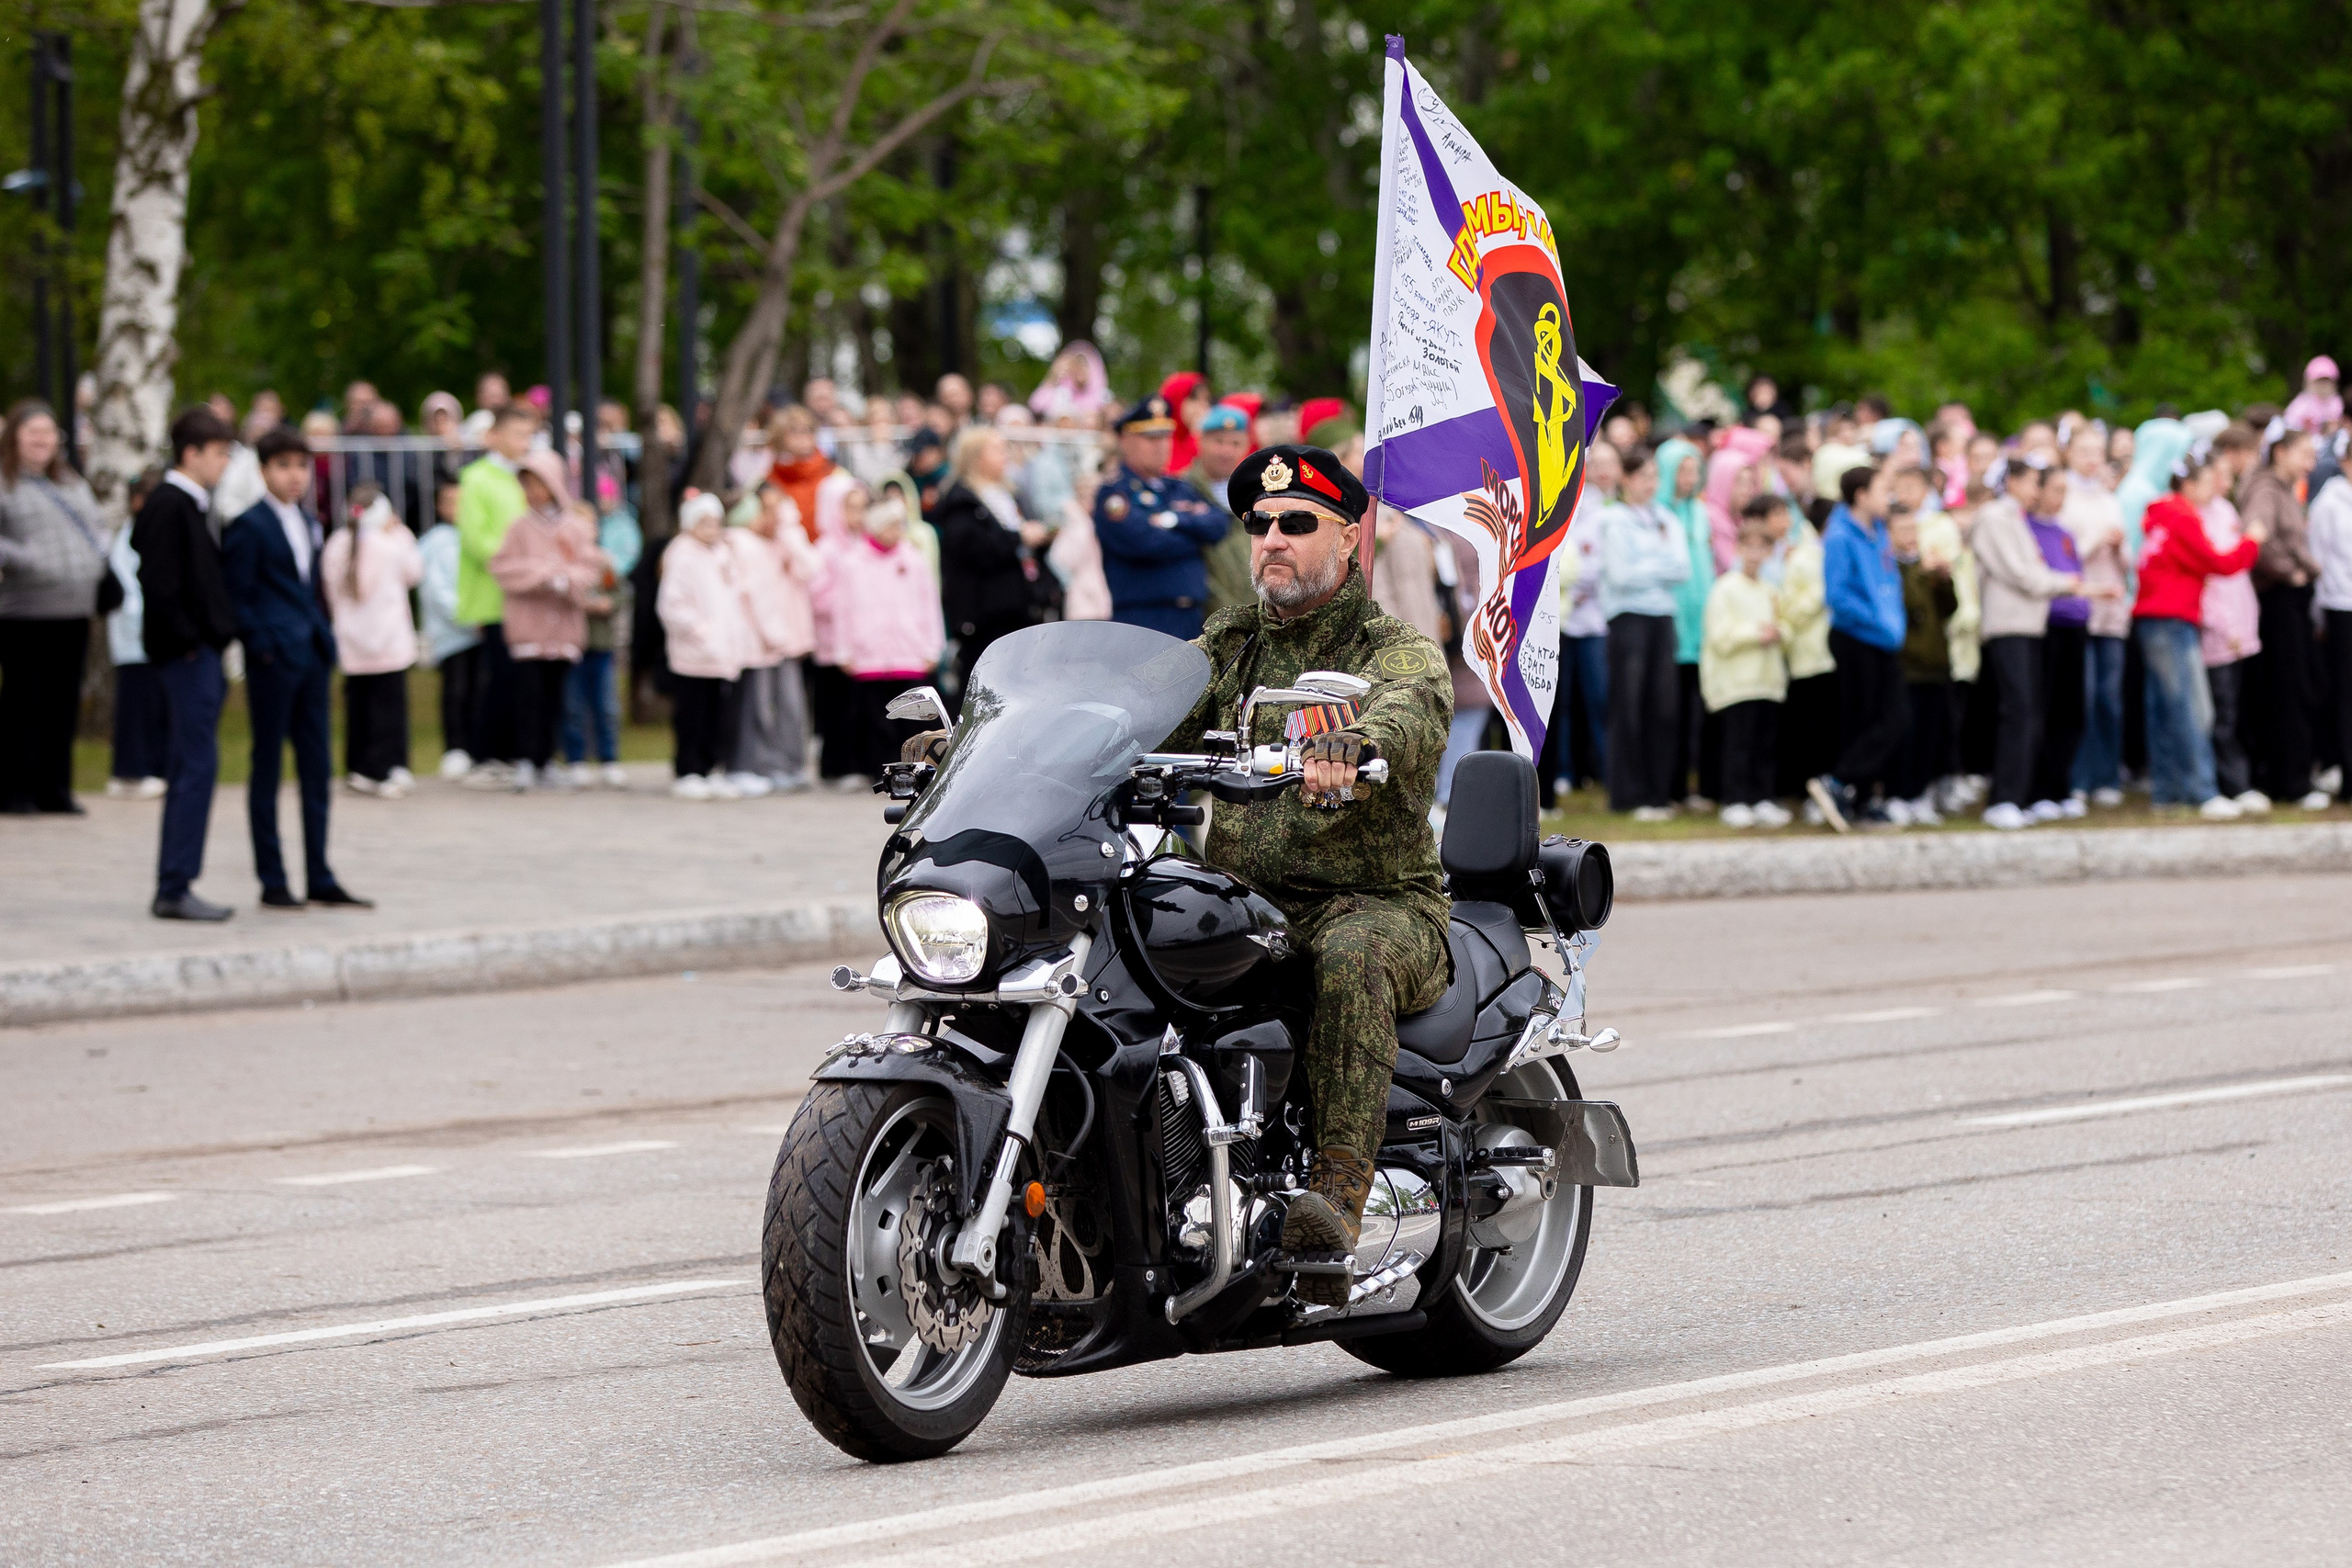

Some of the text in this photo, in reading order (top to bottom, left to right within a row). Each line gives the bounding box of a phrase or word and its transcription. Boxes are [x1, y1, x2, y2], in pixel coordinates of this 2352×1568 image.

[1401, 273, 1417, 293] 155
[1443, 295, 1465, 317] ПАУК
[1408, 1117, 1440, 1127] M109R
